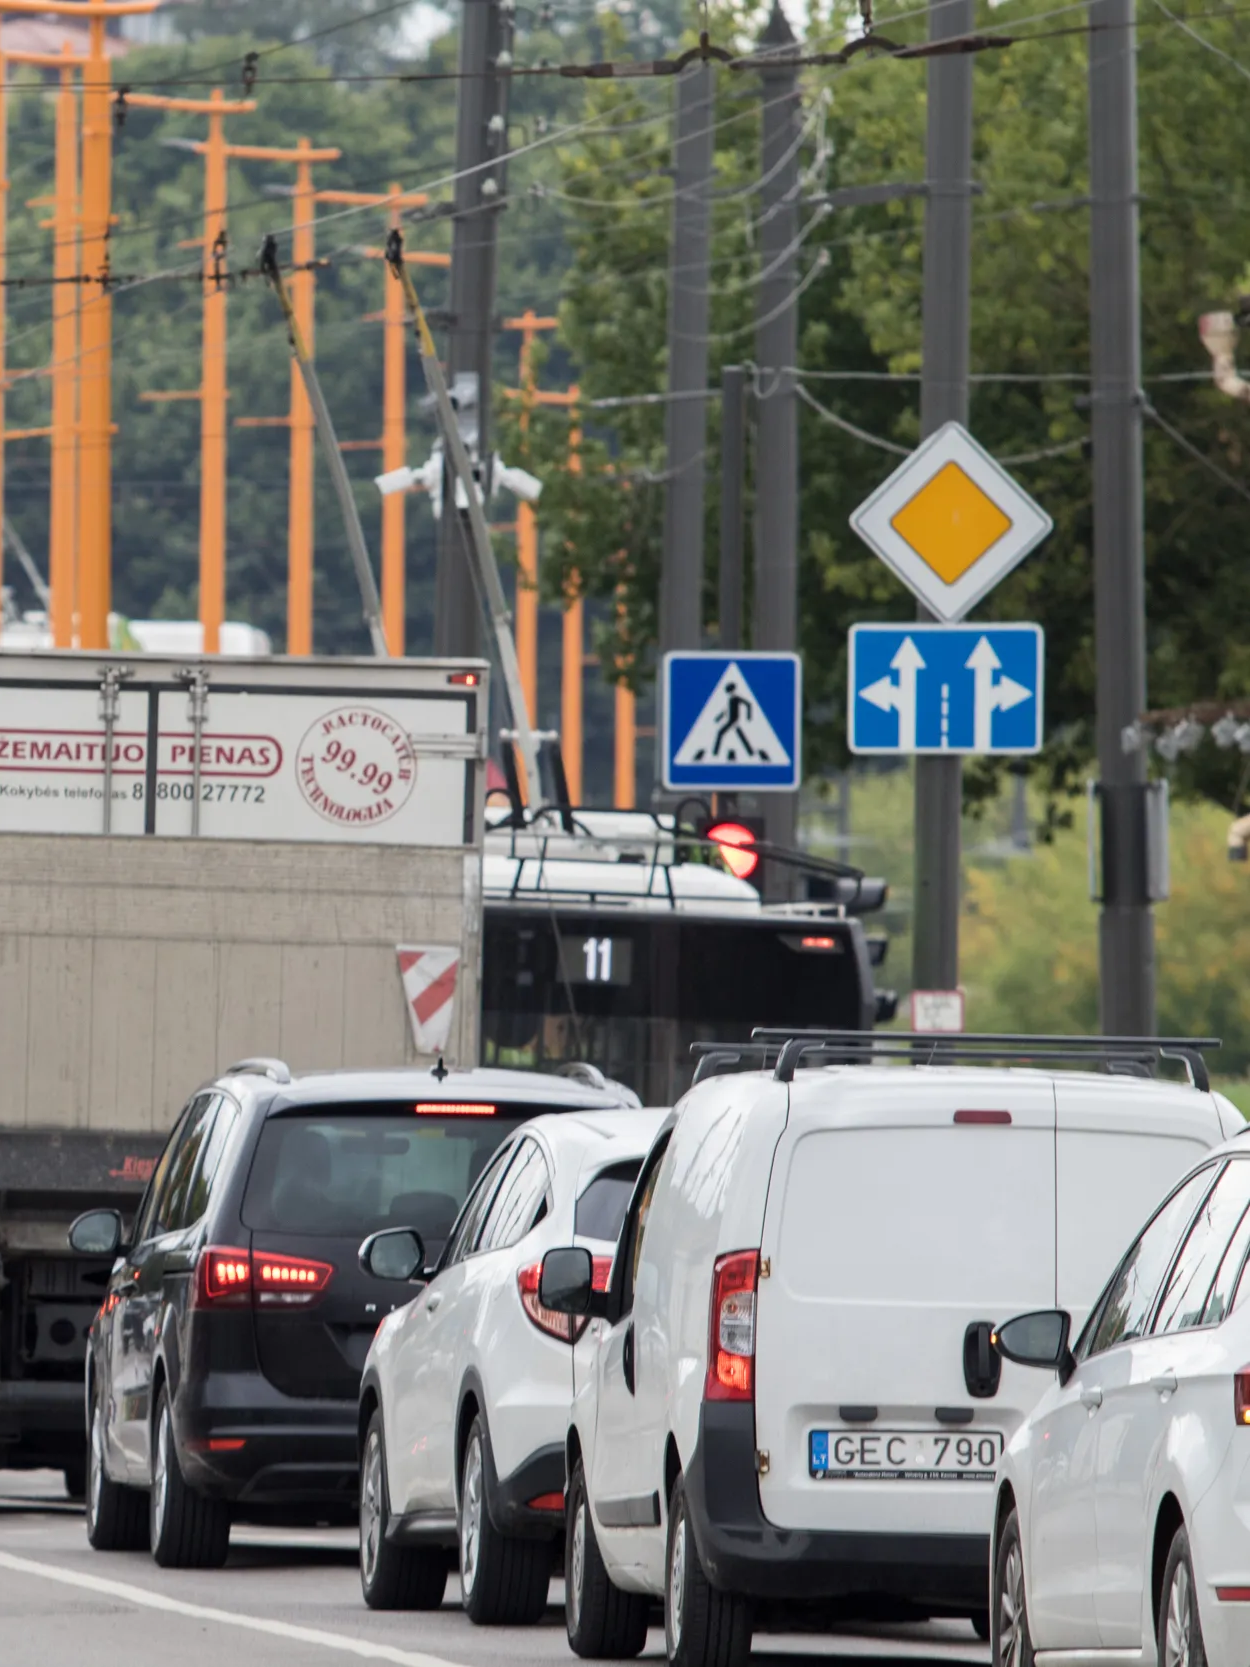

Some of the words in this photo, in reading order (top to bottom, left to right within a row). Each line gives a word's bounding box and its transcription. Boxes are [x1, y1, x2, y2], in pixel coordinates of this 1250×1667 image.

[170, 744, 271, 766] PIENAS
[320, 740, 393, 796] 99.99
[64, 786, 127, 800] telefoas
[132, 782, 144, 801] 8
[156, 782, 194, 801] 800
[202, 784, 266, 803] 27772
[582, 937, 612, 982] 11
[813, 1453, 827, 1465] LT
[834, 1436, 906, 1466] GEC
[933, 1437, 995, 1467] 790
